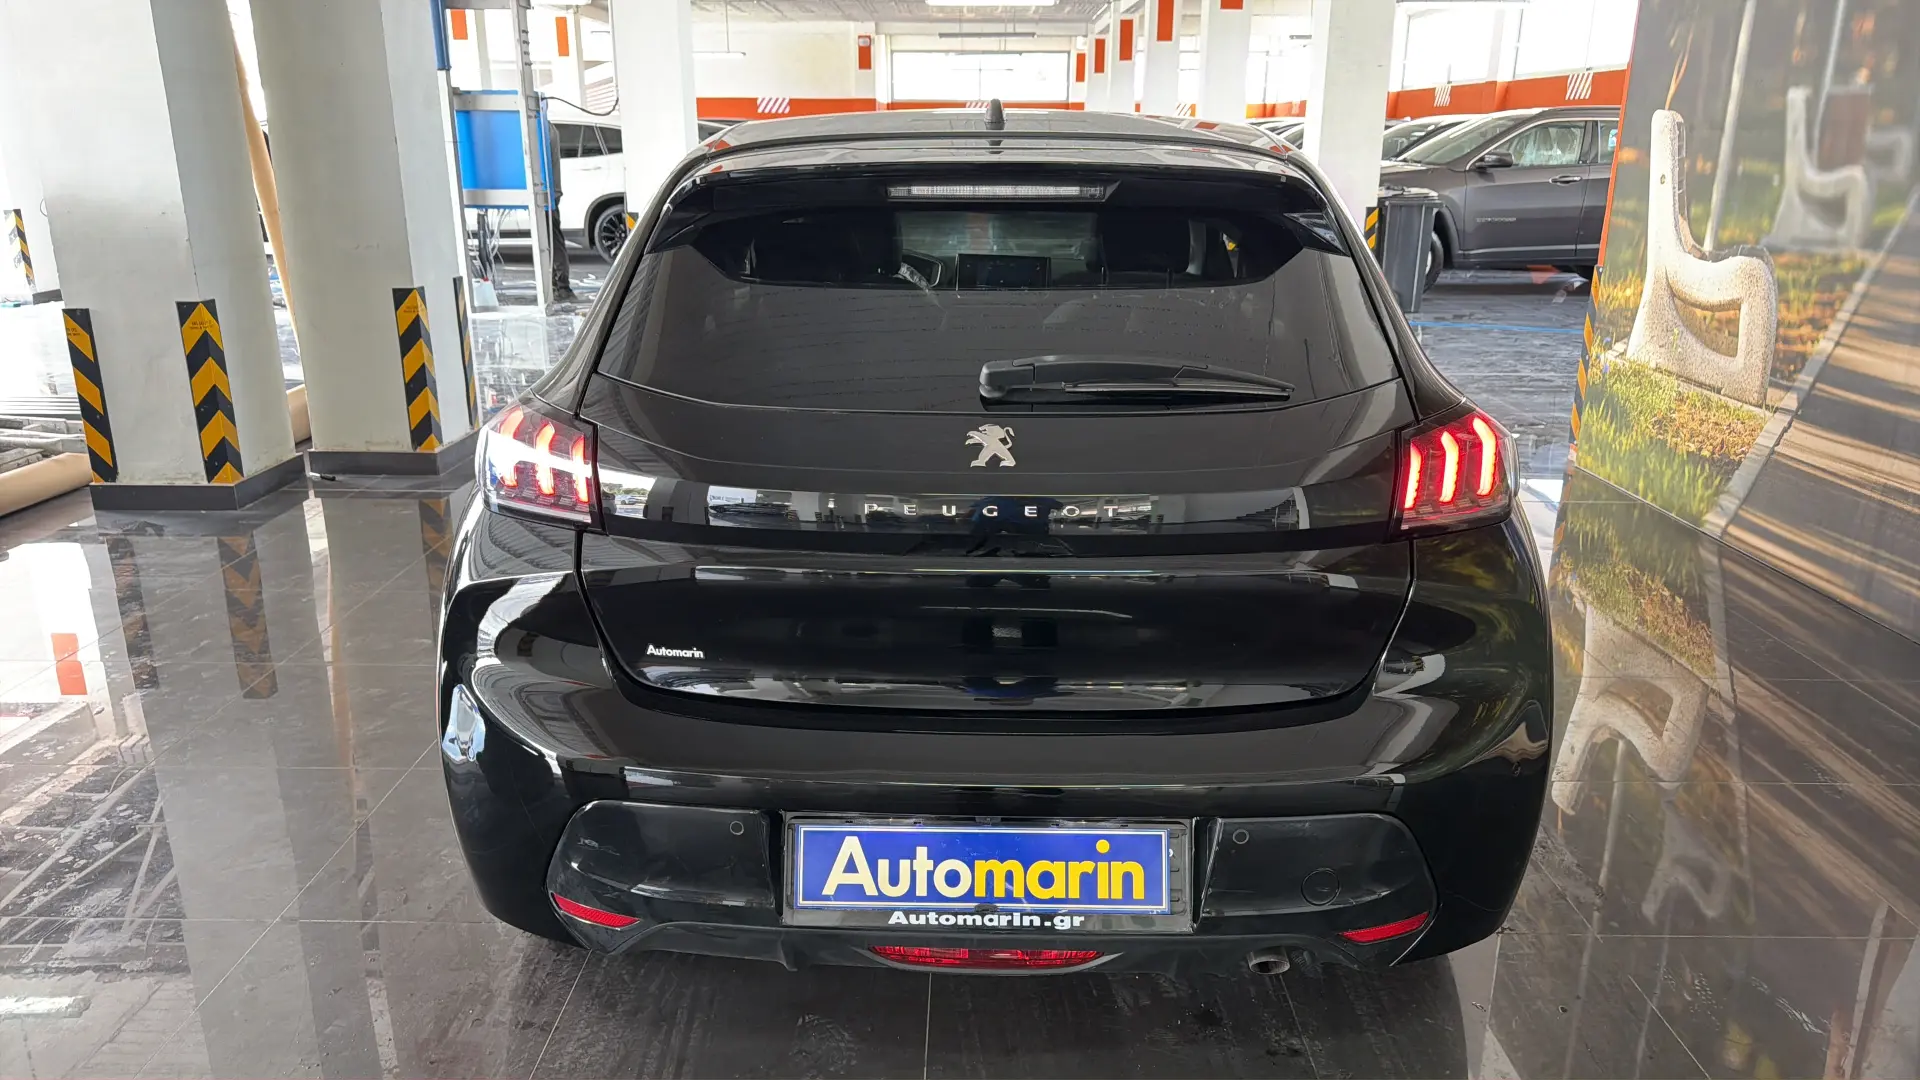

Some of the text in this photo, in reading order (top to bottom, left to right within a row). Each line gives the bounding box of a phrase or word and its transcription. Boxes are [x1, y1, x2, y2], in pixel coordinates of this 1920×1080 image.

[865, 504, 1118, 517] PEUGEOT
[647, 644, 704, 659] Automarin
[821, 835, 1145, 899] Automarin
[888, 911, 1085, 930] Automarin.gr
